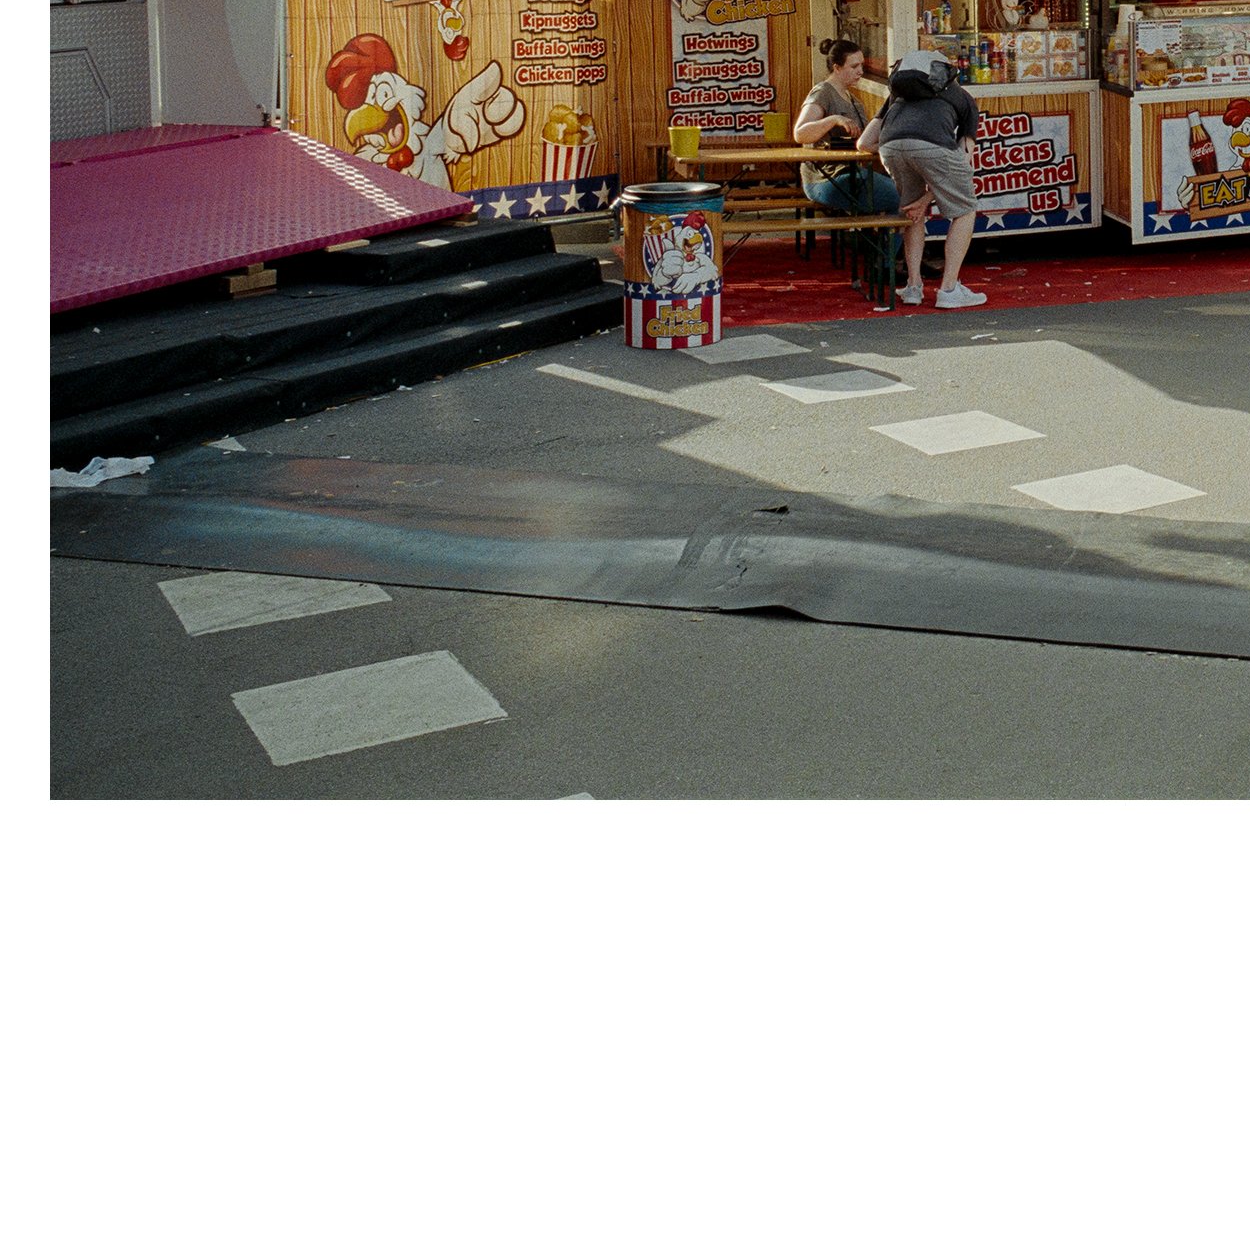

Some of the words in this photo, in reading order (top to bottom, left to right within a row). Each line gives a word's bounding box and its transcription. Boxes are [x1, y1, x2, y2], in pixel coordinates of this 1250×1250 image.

[520, 10, 596, 33] Kipnuggets
[514, 40, 568, 59] Buffalo
[570, 38, 605, 59] wings
[684, 34, 757, 54] Hotwings
[516, 65, 573, 85] Chicken
[576, 65, 607, 85] pops
[676, 59, 762, 81] Kipnuggets
[669, 88, 728, 107] Buffalo
[729, 87, 775, 105] wings
[671, 113, 735, 129] Chicken
[736, 113, 764, 130] pop
[976, 113, 1031, 140] Even
[1030, 189, 1060, 212] us
[1200, 176, 1247, 208] EAT
[659, 304, 701, 322] Fried
[646, 318, 709, 337] Chicken
